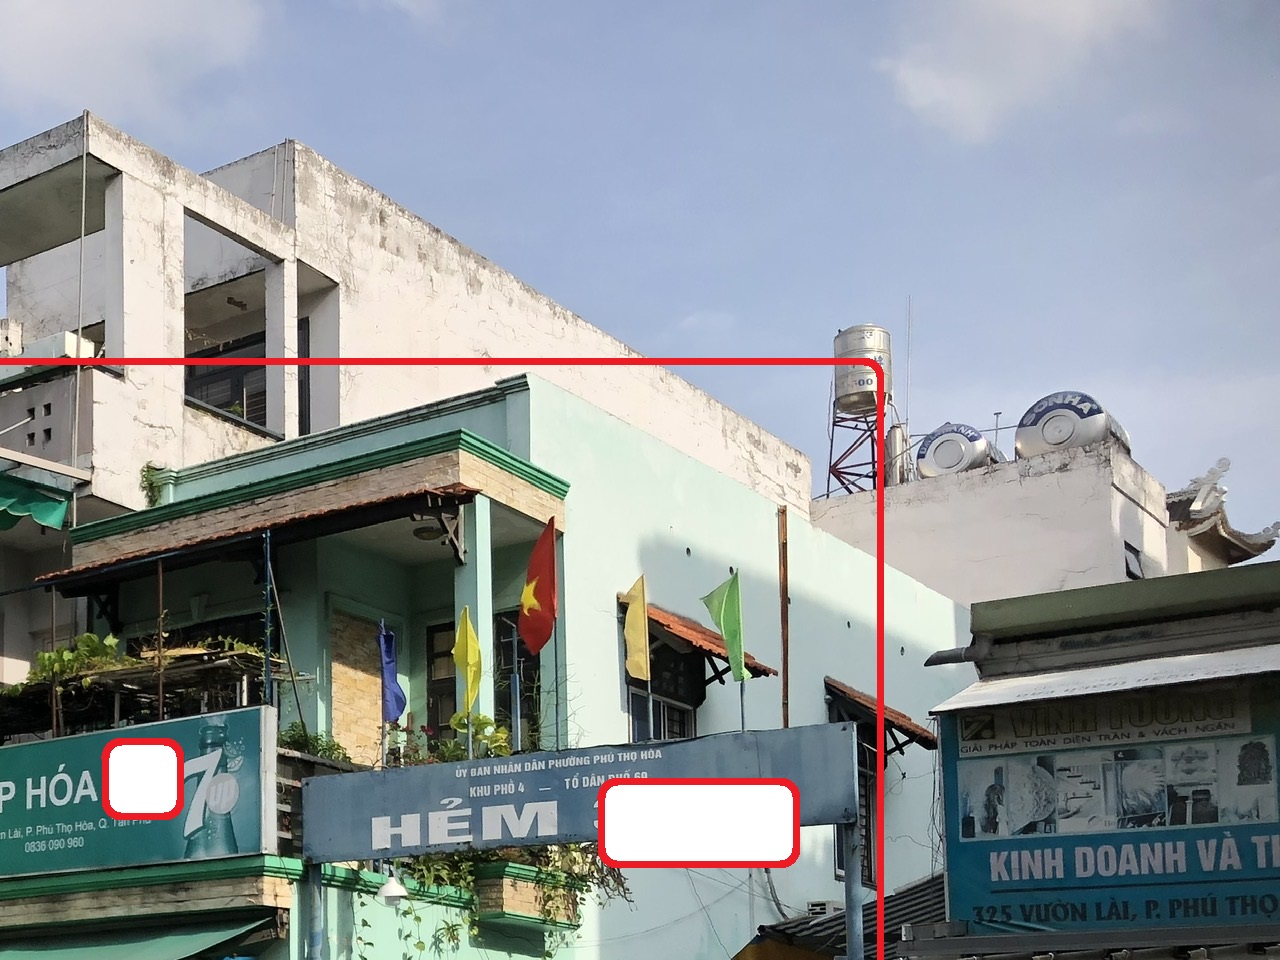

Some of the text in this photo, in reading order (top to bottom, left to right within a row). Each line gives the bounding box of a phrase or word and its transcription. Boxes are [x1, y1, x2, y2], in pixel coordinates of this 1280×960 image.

[988, 739, 1018, 751] PHÁP
[1024, 736, 1057, 748] TOÀN
[1137, 730, 1146, 739] &
[1153, 725, 1188, 737] VÁCH
[470, 766, 491, 777] BAN
[493, 762, 522, 775] NHÂN
[524, 759, 546, 772] DÂN
[548, 755, 591, 769] PHƯỜNG
[593, 753, 616, 765] PHÚ
[617, 752, 638, 763] THỌ
[640, 749, 662, 761] HÒA
[26, 764, 98, 809] HÓA
[469, 785, 491, 798] KHU
[518, 782, 525, 793] 4
[564, 773, 579, 789] TỔ
[582, 774, 605, 787] DÂN
[25, 827, 34, 836] P.
[36, 825, 54, 836] Phú
[56, 823, 73, 834] Thọ
[75, 821, 96, 832] Hòa,
[372, 797, 558, 850] HẺM
[25, 837, 84, 852] 0836 090 960
[990, 847, 1064, 882] KINH
[1075, 841, 1187, 878] DOANH
[1196, 831, 1242, 872] VÀ
[972, 904, 1013, 925] 325
[1020, 900, 1088, 924] VƯỜN
[1095, 896, 1138, 923] LÀI,
[1145, 899, 1161, 920] P.
[1168, 892, 1218, 918] PHÚ
